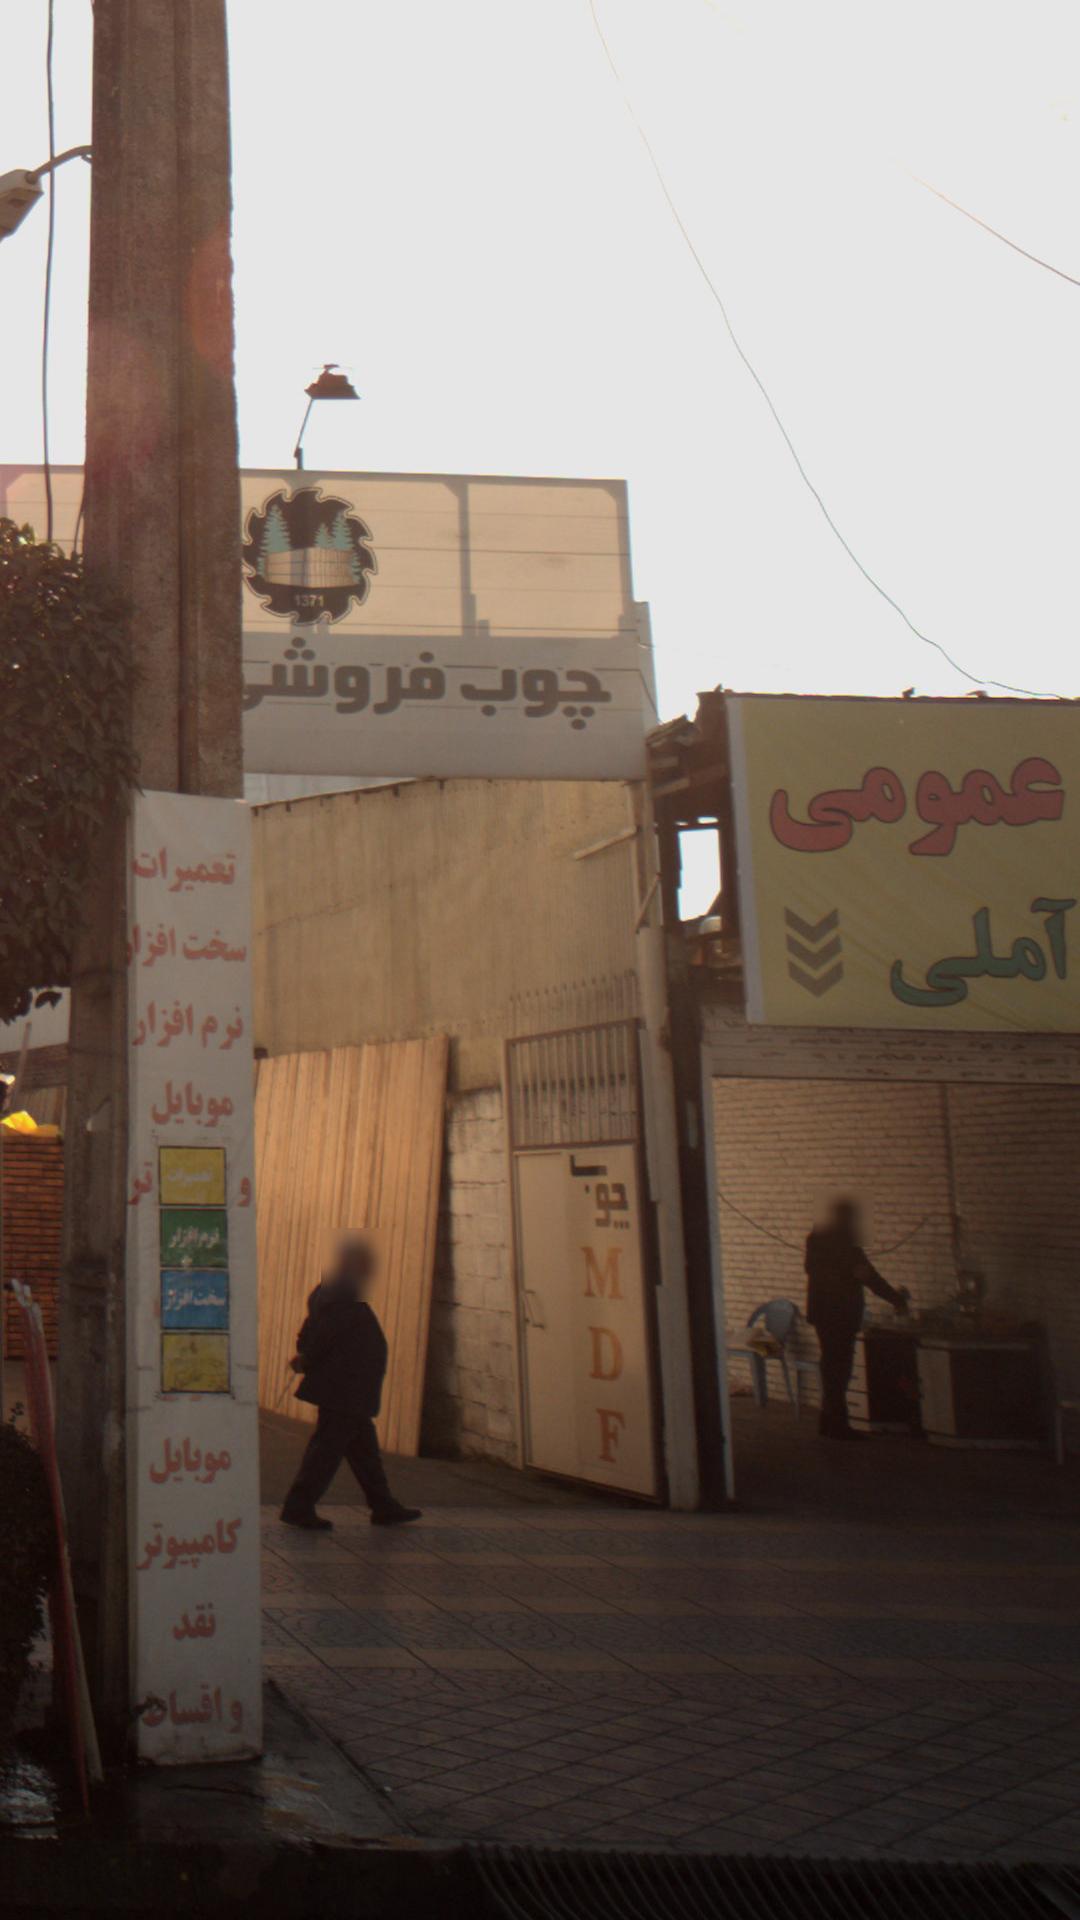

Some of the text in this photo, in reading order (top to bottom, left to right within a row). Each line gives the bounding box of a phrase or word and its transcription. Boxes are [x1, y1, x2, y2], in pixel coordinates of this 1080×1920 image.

[294, 593, 325, 608] 1371
[460, 666, 613, 731] چوب
[769, 756, 1066, 857] عمومی
[131, 847, 236, 892] تعمیرات
[182, 929, 247, 962] سخت
[890, 897, 1078, 1008] آملی
[131, 1000, 244, 1050] نرم افزار
[151, 1080, 234, 1128] موبایل
[149, 1437, 233, 1485] موبایل
[135, 1517, 242, 1571] کامپیوتر
[171, 1602, 217, 1641] نقد
